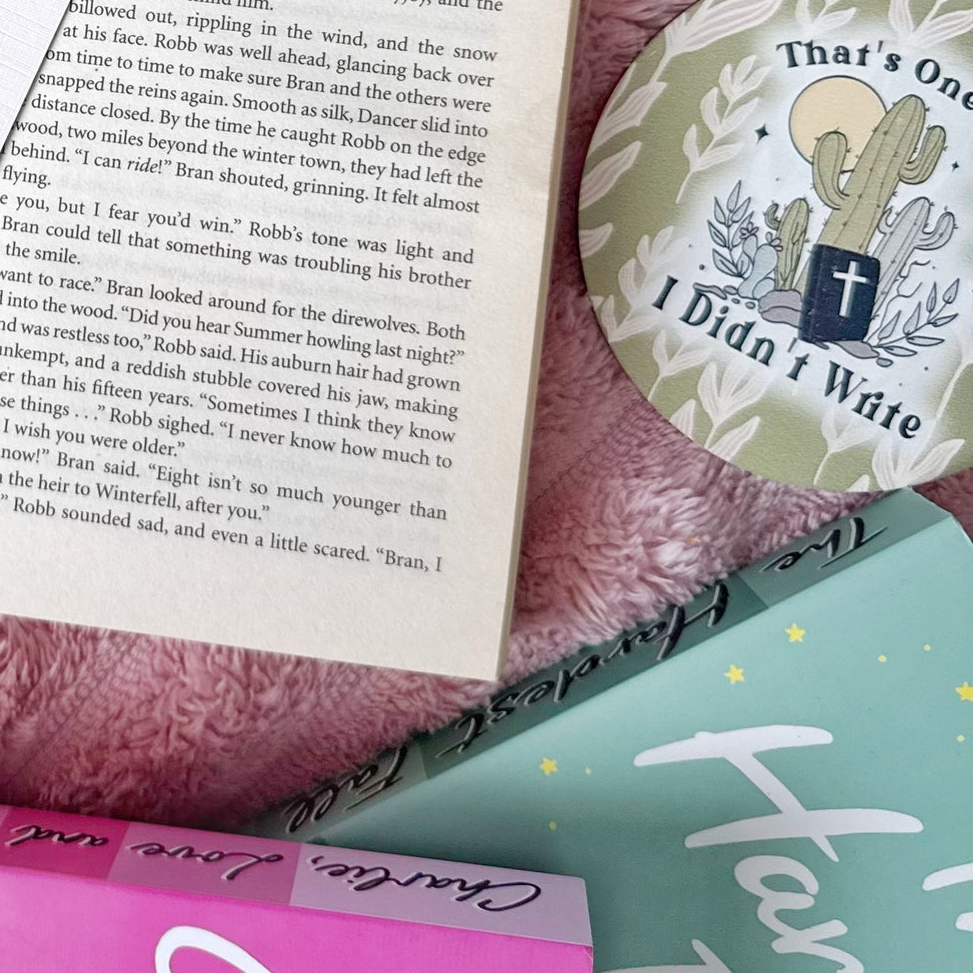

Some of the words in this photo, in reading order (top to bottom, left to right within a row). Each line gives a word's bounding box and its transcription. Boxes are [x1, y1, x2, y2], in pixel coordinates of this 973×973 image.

[776, 39, 902, 74] That's
[914, 58, 973, 111] One
[652, 275, 678, 311] I
[678, 290, 810, 381] Didn't
[824, 360, 921, 439] Write
[0, 447, 50, 464] now!”
[56, 451, 95, 472] Bran
[103, 459, 140, 478] said.
[148, 463, 200, 488] “Eight
[207, 476, 242, 492] isn’t
[249, 482, 268, 495] so
[276, 485, 324, 504] much
[332, 493, 402, 517] younger
[409, 500, 447, 521] than
[13, 496, 56, 517] Robb
[61, 507, 131, 529] sounded
[136, 516, 169, 536] sad,
[174, 522, 205, 539] and
[211, 529, 249, 545] even
[254, 535, 264, 548] a
[269, 532, 308, 553] little
[313, 543, 370, 562] scared.
[375, 547, 429, 573] “Bran,
[435, 556, 442, 573] I
[758, 515, 890, 574] The
[435, 579, 729, 758] Hardest
[281, 745, 408, 834] Fall
[5, 823, 111, 849] and
[129, 839, 286, 882] Love
[311, 855, 542, 912] Charlie,
